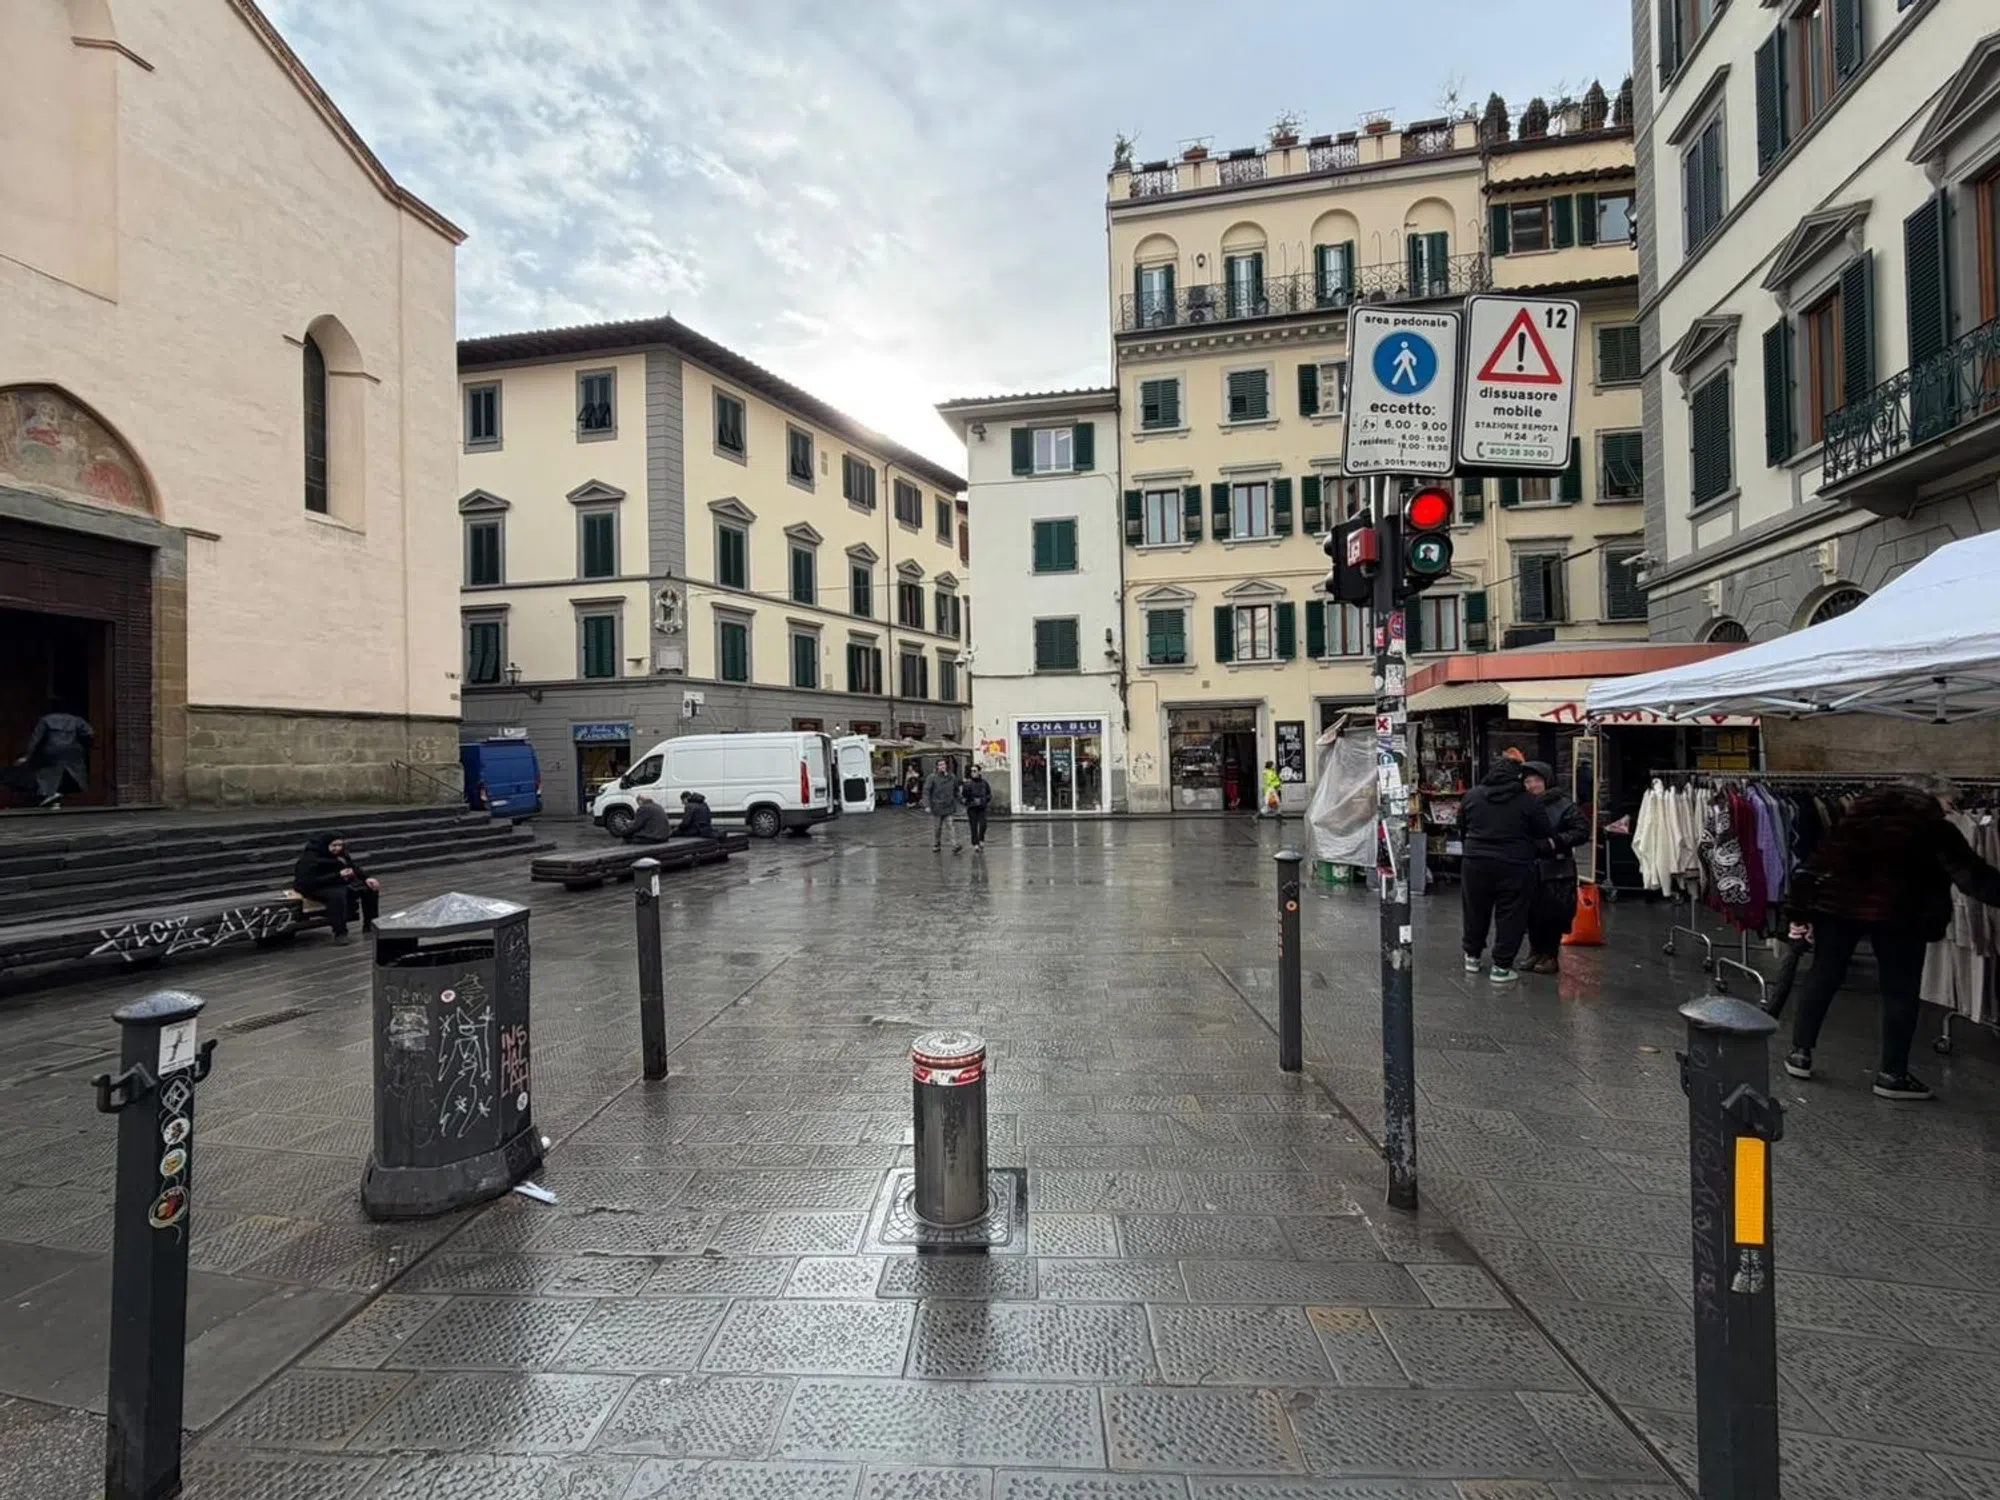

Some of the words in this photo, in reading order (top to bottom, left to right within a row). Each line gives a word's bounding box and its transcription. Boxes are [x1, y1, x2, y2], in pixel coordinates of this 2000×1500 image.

[1364, 315, 1390, 325] area
[1393, 316, 1449, 328] pedonale
[1545, 307, 1568, 329] 12
[1479, 387, 1558, 402] dissuasore
[1370, 402, 1436, 416] eccetto:
[1493, 405, 1543, 417] mobile
[1474, 421, 1520, 431] STAZIONE
[1521, 423, 1559, 432] REMOTA
[1504, 432, 1512, 440] H
[1021, 722, 1062, 731] ZONA
[1069, 721, 1098, 730] BLU
